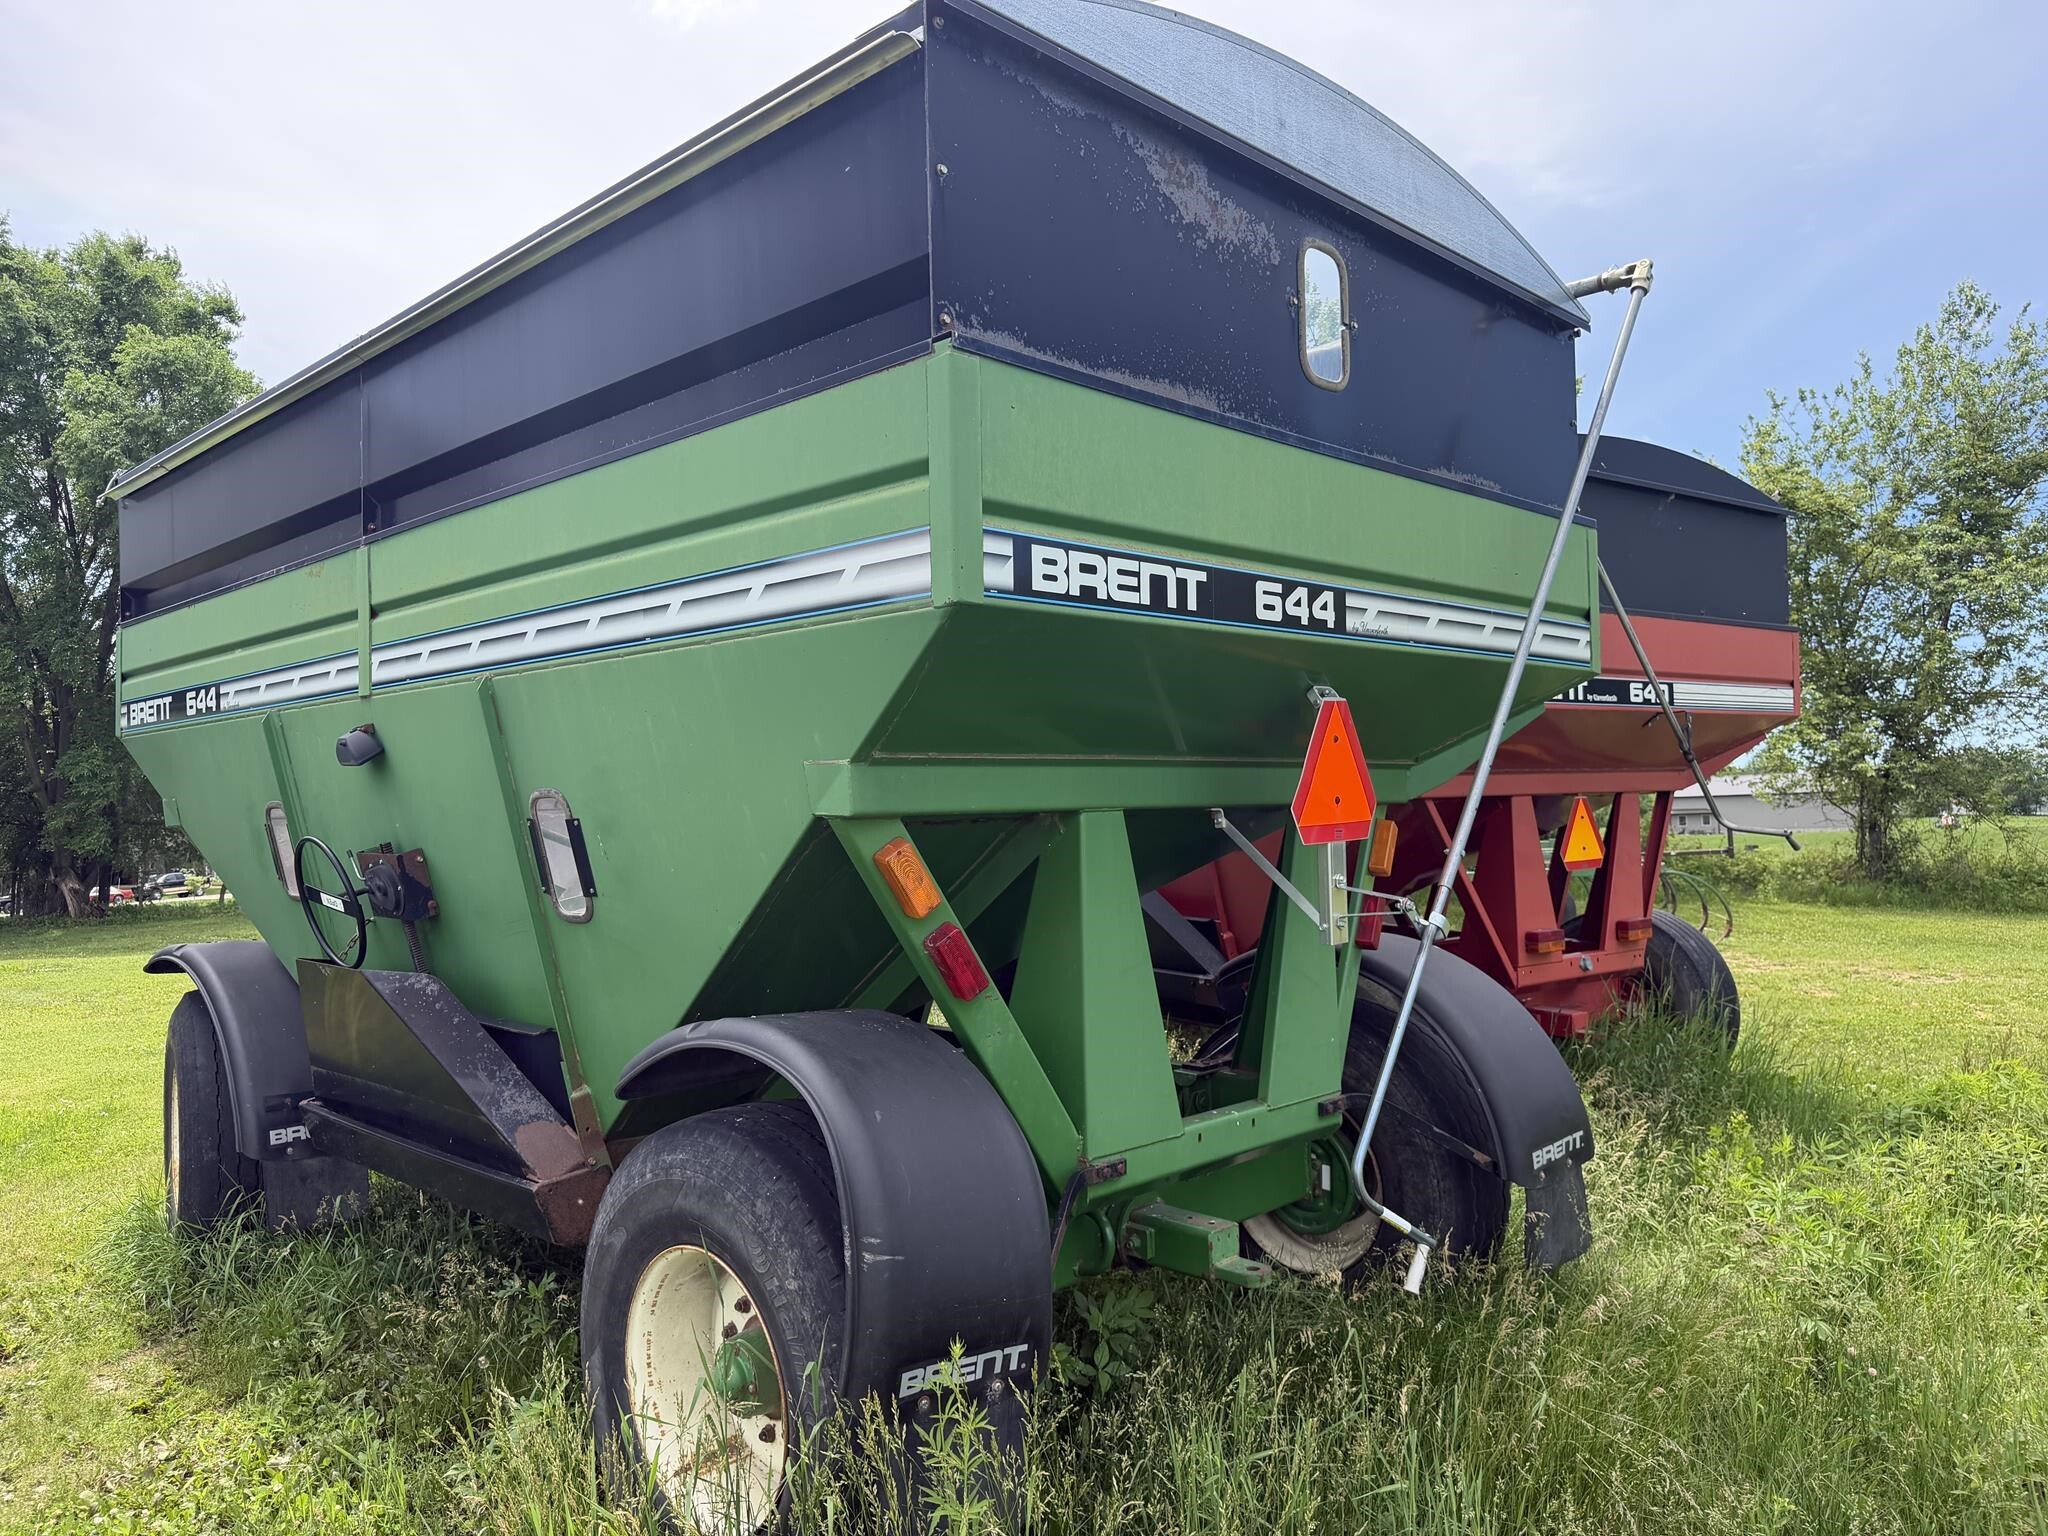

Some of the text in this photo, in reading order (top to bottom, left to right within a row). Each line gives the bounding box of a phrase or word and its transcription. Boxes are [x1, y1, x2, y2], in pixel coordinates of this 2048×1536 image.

[1031, 543, 1336, 629] BRENT 644
[129, 695, 173, 726] BRENT
[185, 686, 217, 716] 644
[269, 1125, 311, 1146] BR
[1532, 1130, 1584, 1170] BRENT
